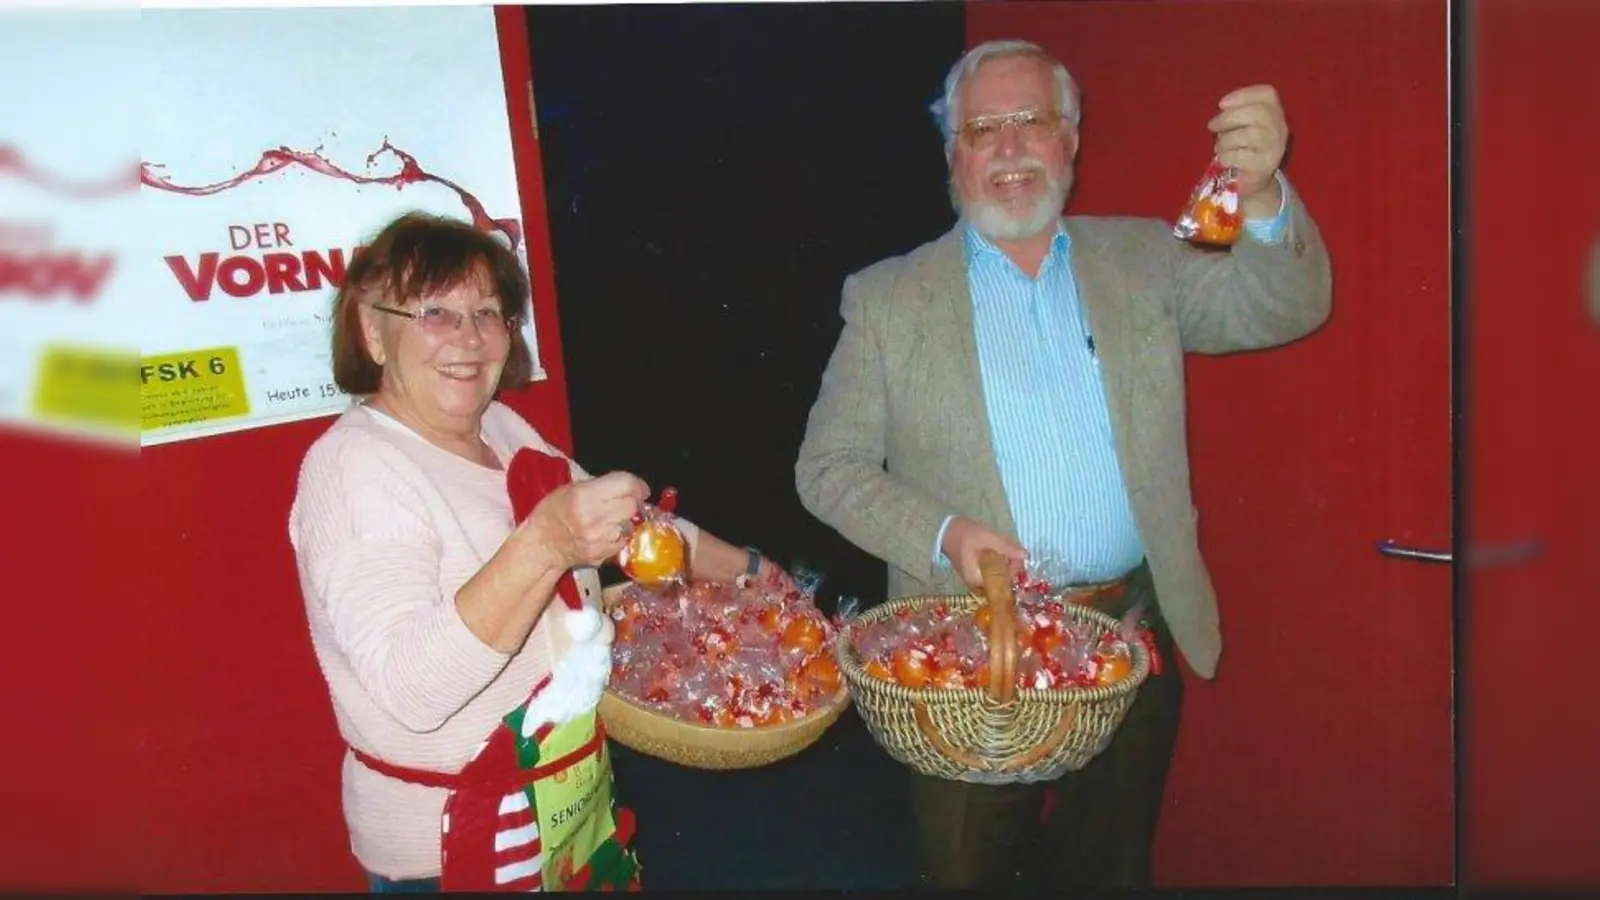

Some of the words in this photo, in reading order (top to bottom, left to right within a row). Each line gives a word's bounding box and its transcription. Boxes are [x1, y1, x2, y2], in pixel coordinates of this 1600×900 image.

[228, 221, 293, 250] DER
[163, 247, 352, 303] VORN
[140, 360, 200, 385] FSK
[209, 356, 226, 376] 6
[267, 387, 311, 402] Heute
